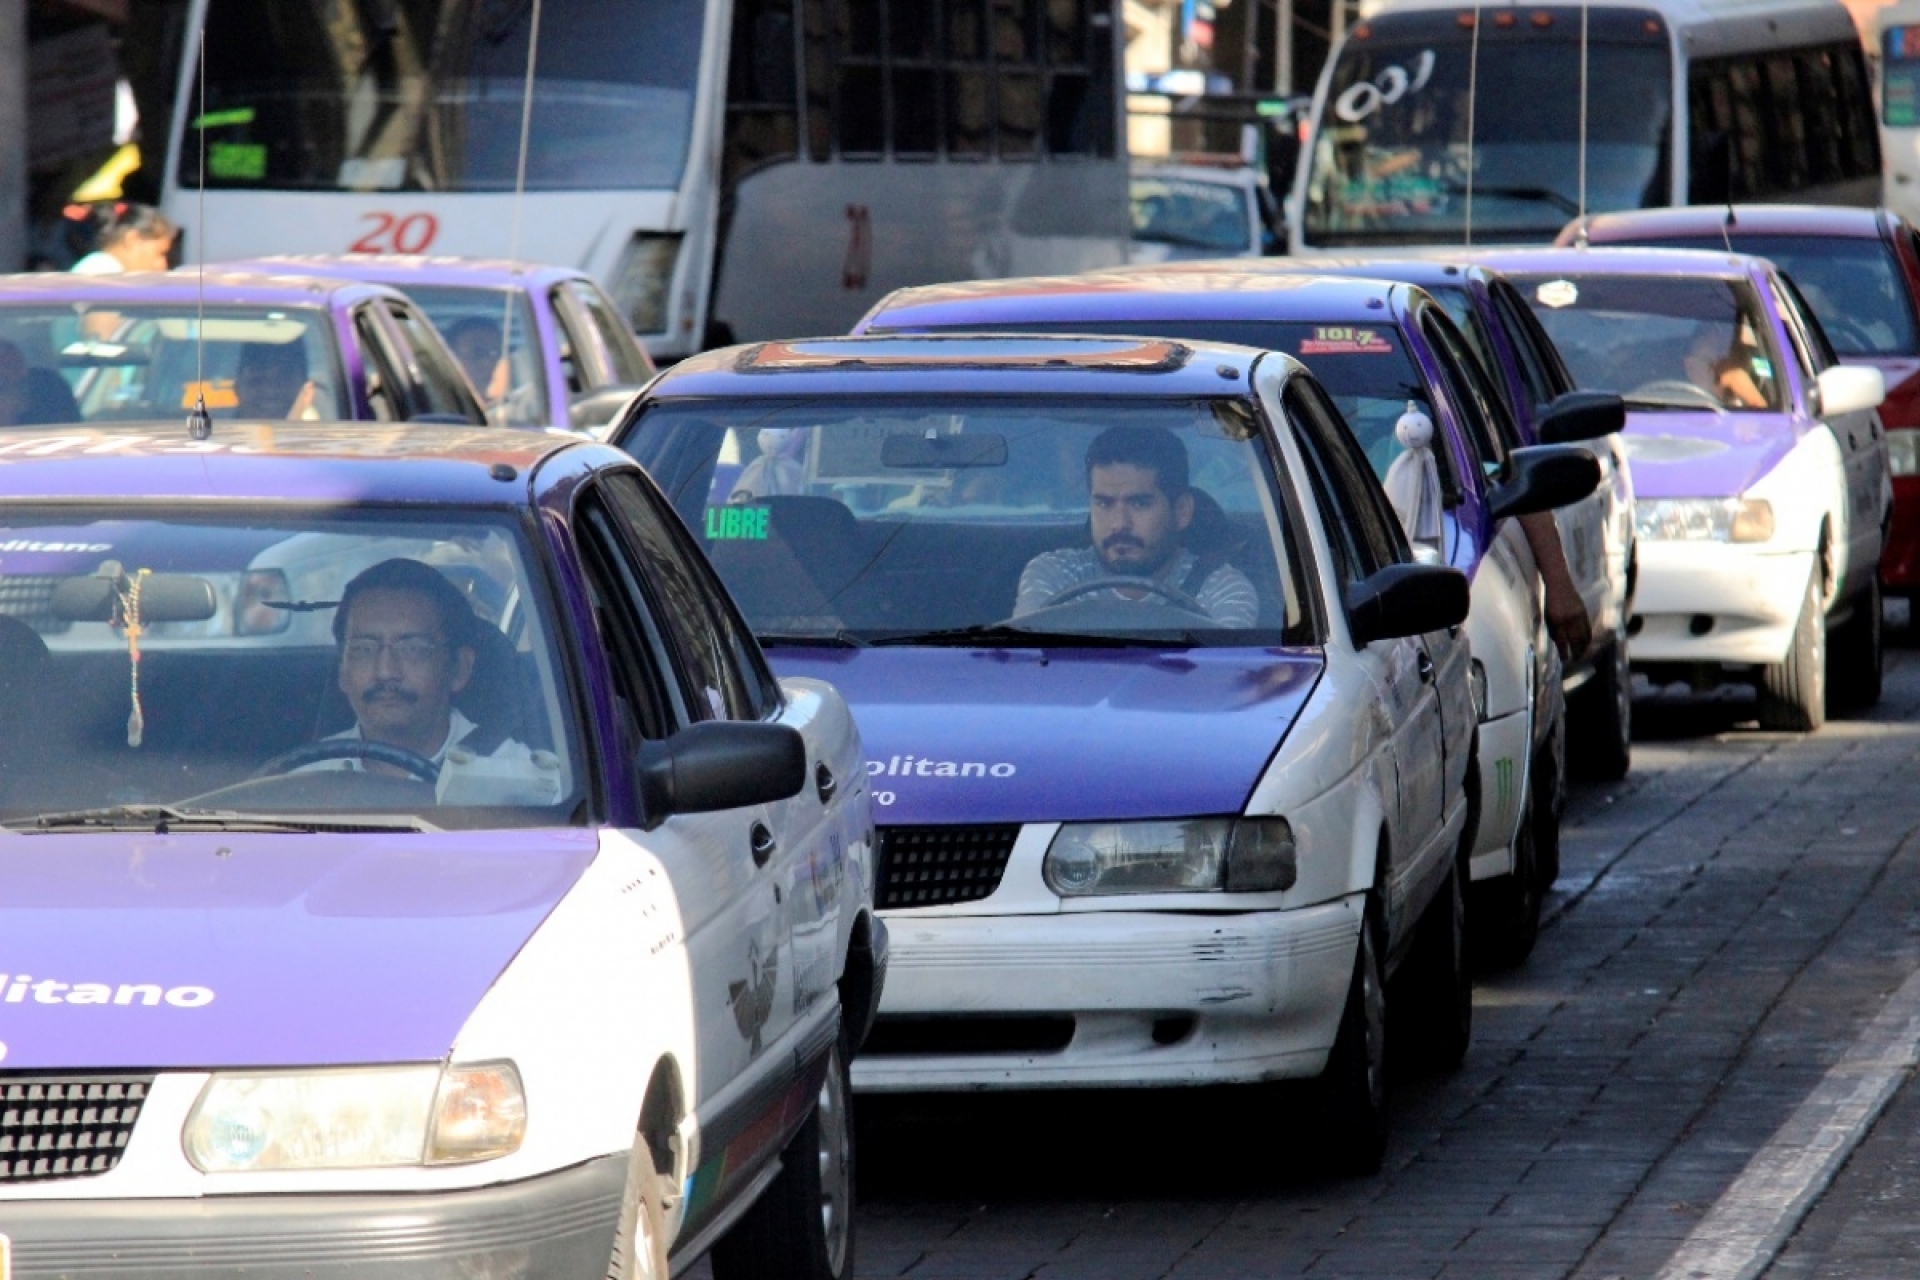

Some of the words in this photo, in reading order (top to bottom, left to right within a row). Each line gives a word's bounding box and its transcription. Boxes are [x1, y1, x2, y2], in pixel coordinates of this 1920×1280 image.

[349, 211, 438, 254] 20
[707, 507, 769, 540] LIBRE
[0, 539, 113, 552] litano
[0, 974, 215, 1007] itano
